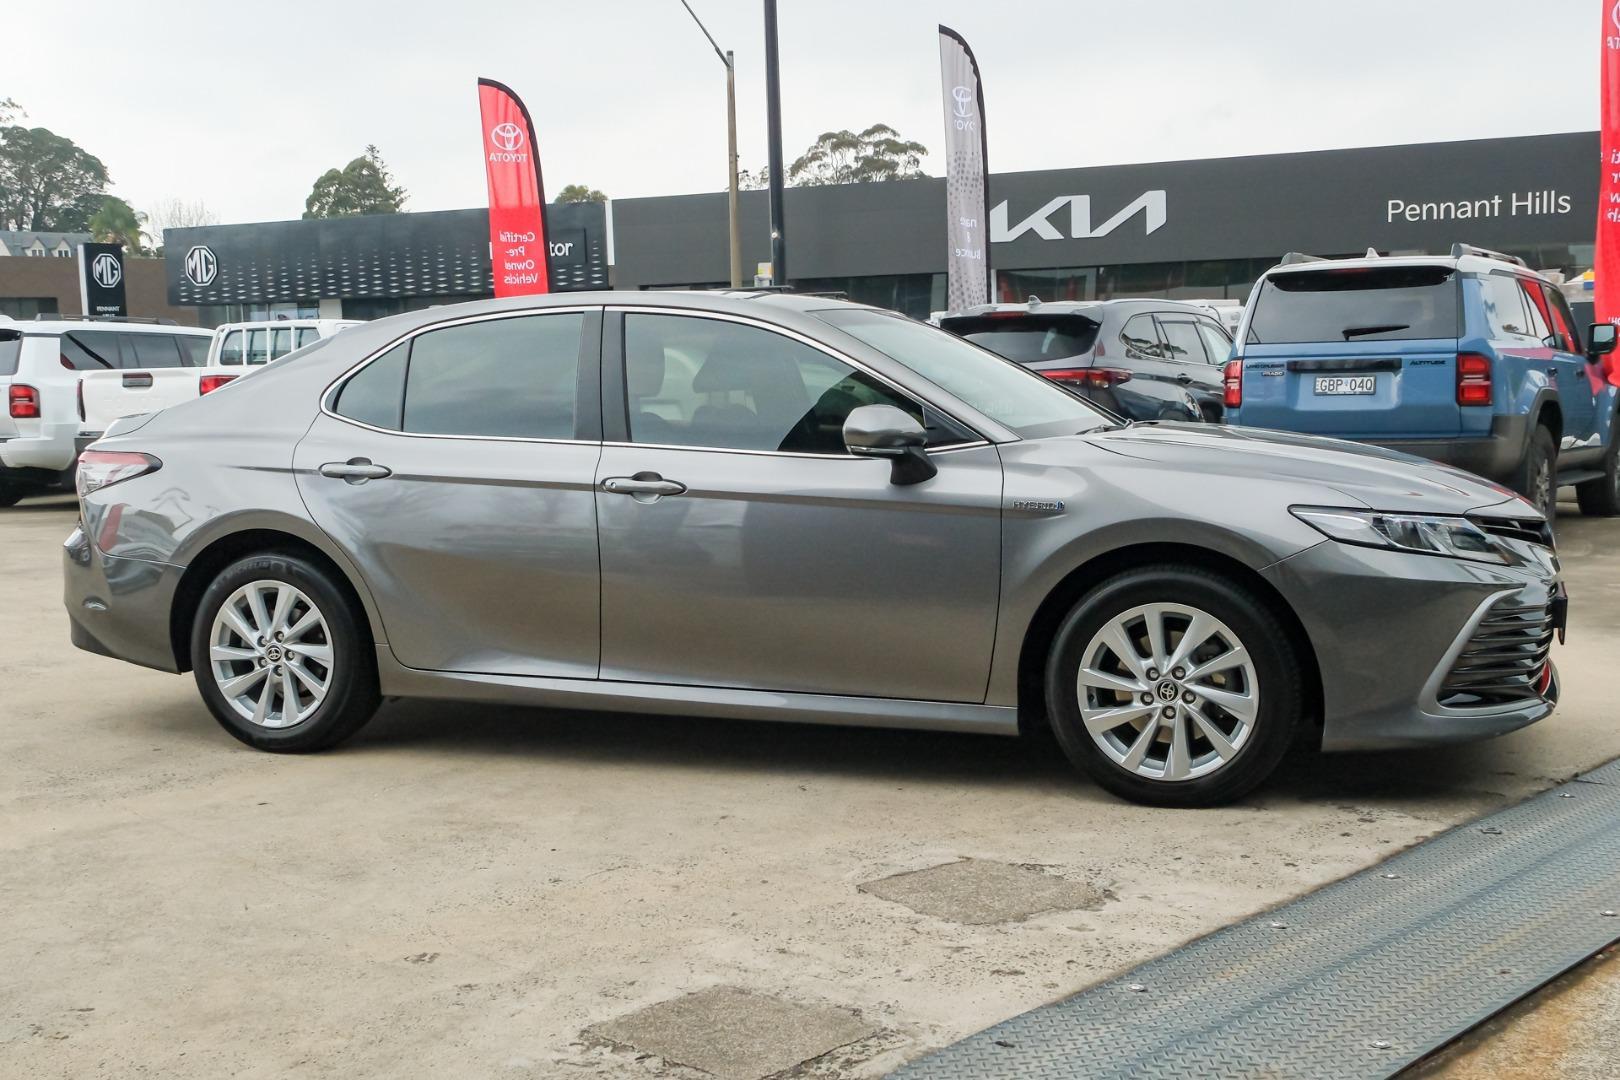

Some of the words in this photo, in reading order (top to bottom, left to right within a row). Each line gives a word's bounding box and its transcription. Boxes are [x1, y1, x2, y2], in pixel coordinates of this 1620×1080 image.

[989, 189, 1167, 243] KIA
[1387, 194, 1503, 223] Pennant
[1511, 190, 1572, 216] Hills
[549, 241, 573, 257] tor
[96, 256, 119, 285] MG
[187, 249, 215, 283] MG
[1319, 378, 1344, 392] GBP
